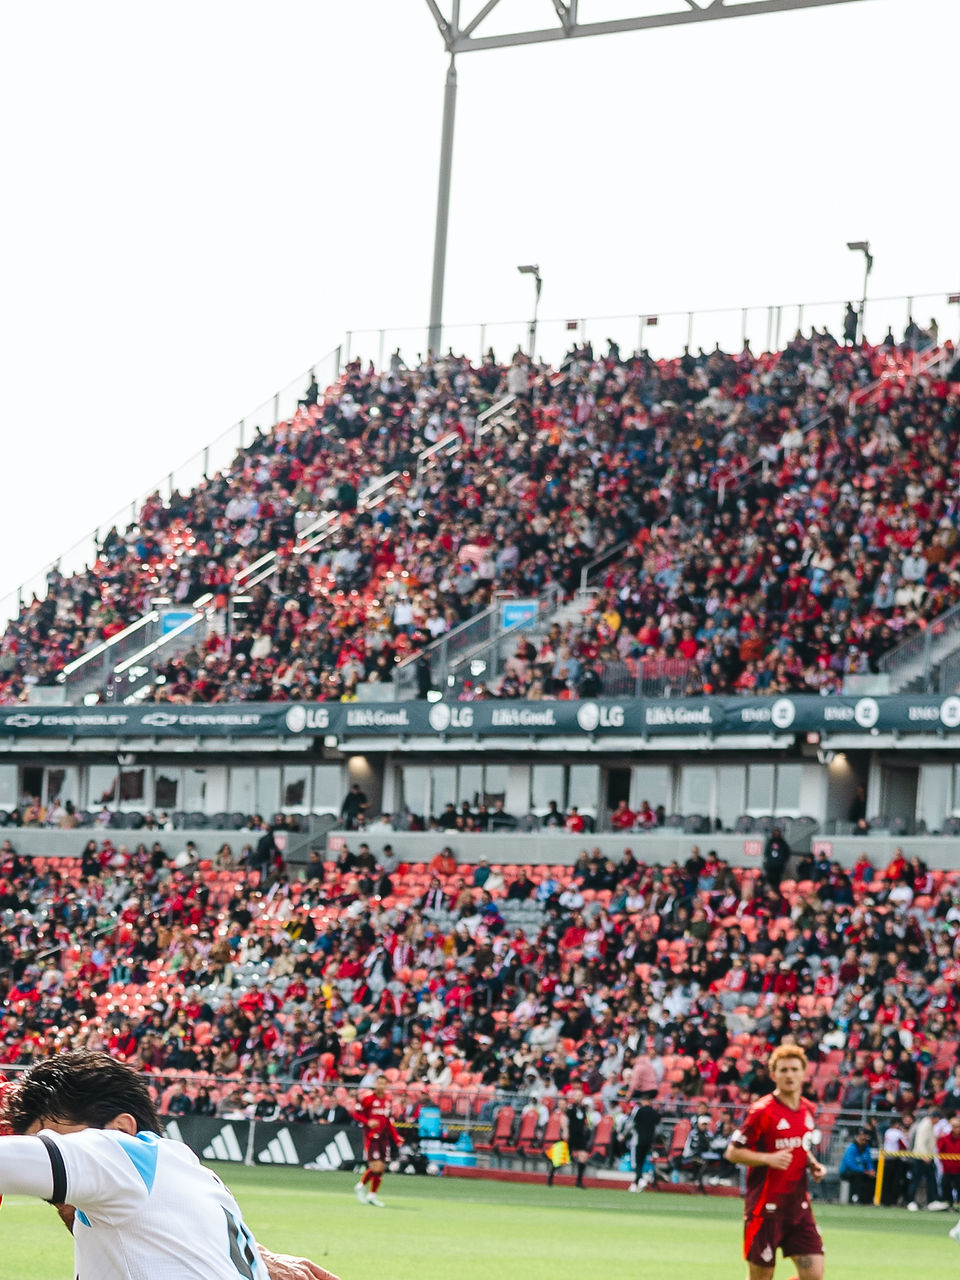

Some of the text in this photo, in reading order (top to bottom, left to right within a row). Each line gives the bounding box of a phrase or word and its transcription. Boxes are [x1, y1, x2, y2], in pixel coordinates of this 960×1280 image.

[42, 715, 128, 726] CHEVROLET
[179, 714, 261, 725] CHEVROLET
[306, 708, 329, 728] LG
[451, 707, 473, 727] LG
[600, 706, 624, 727] LG
